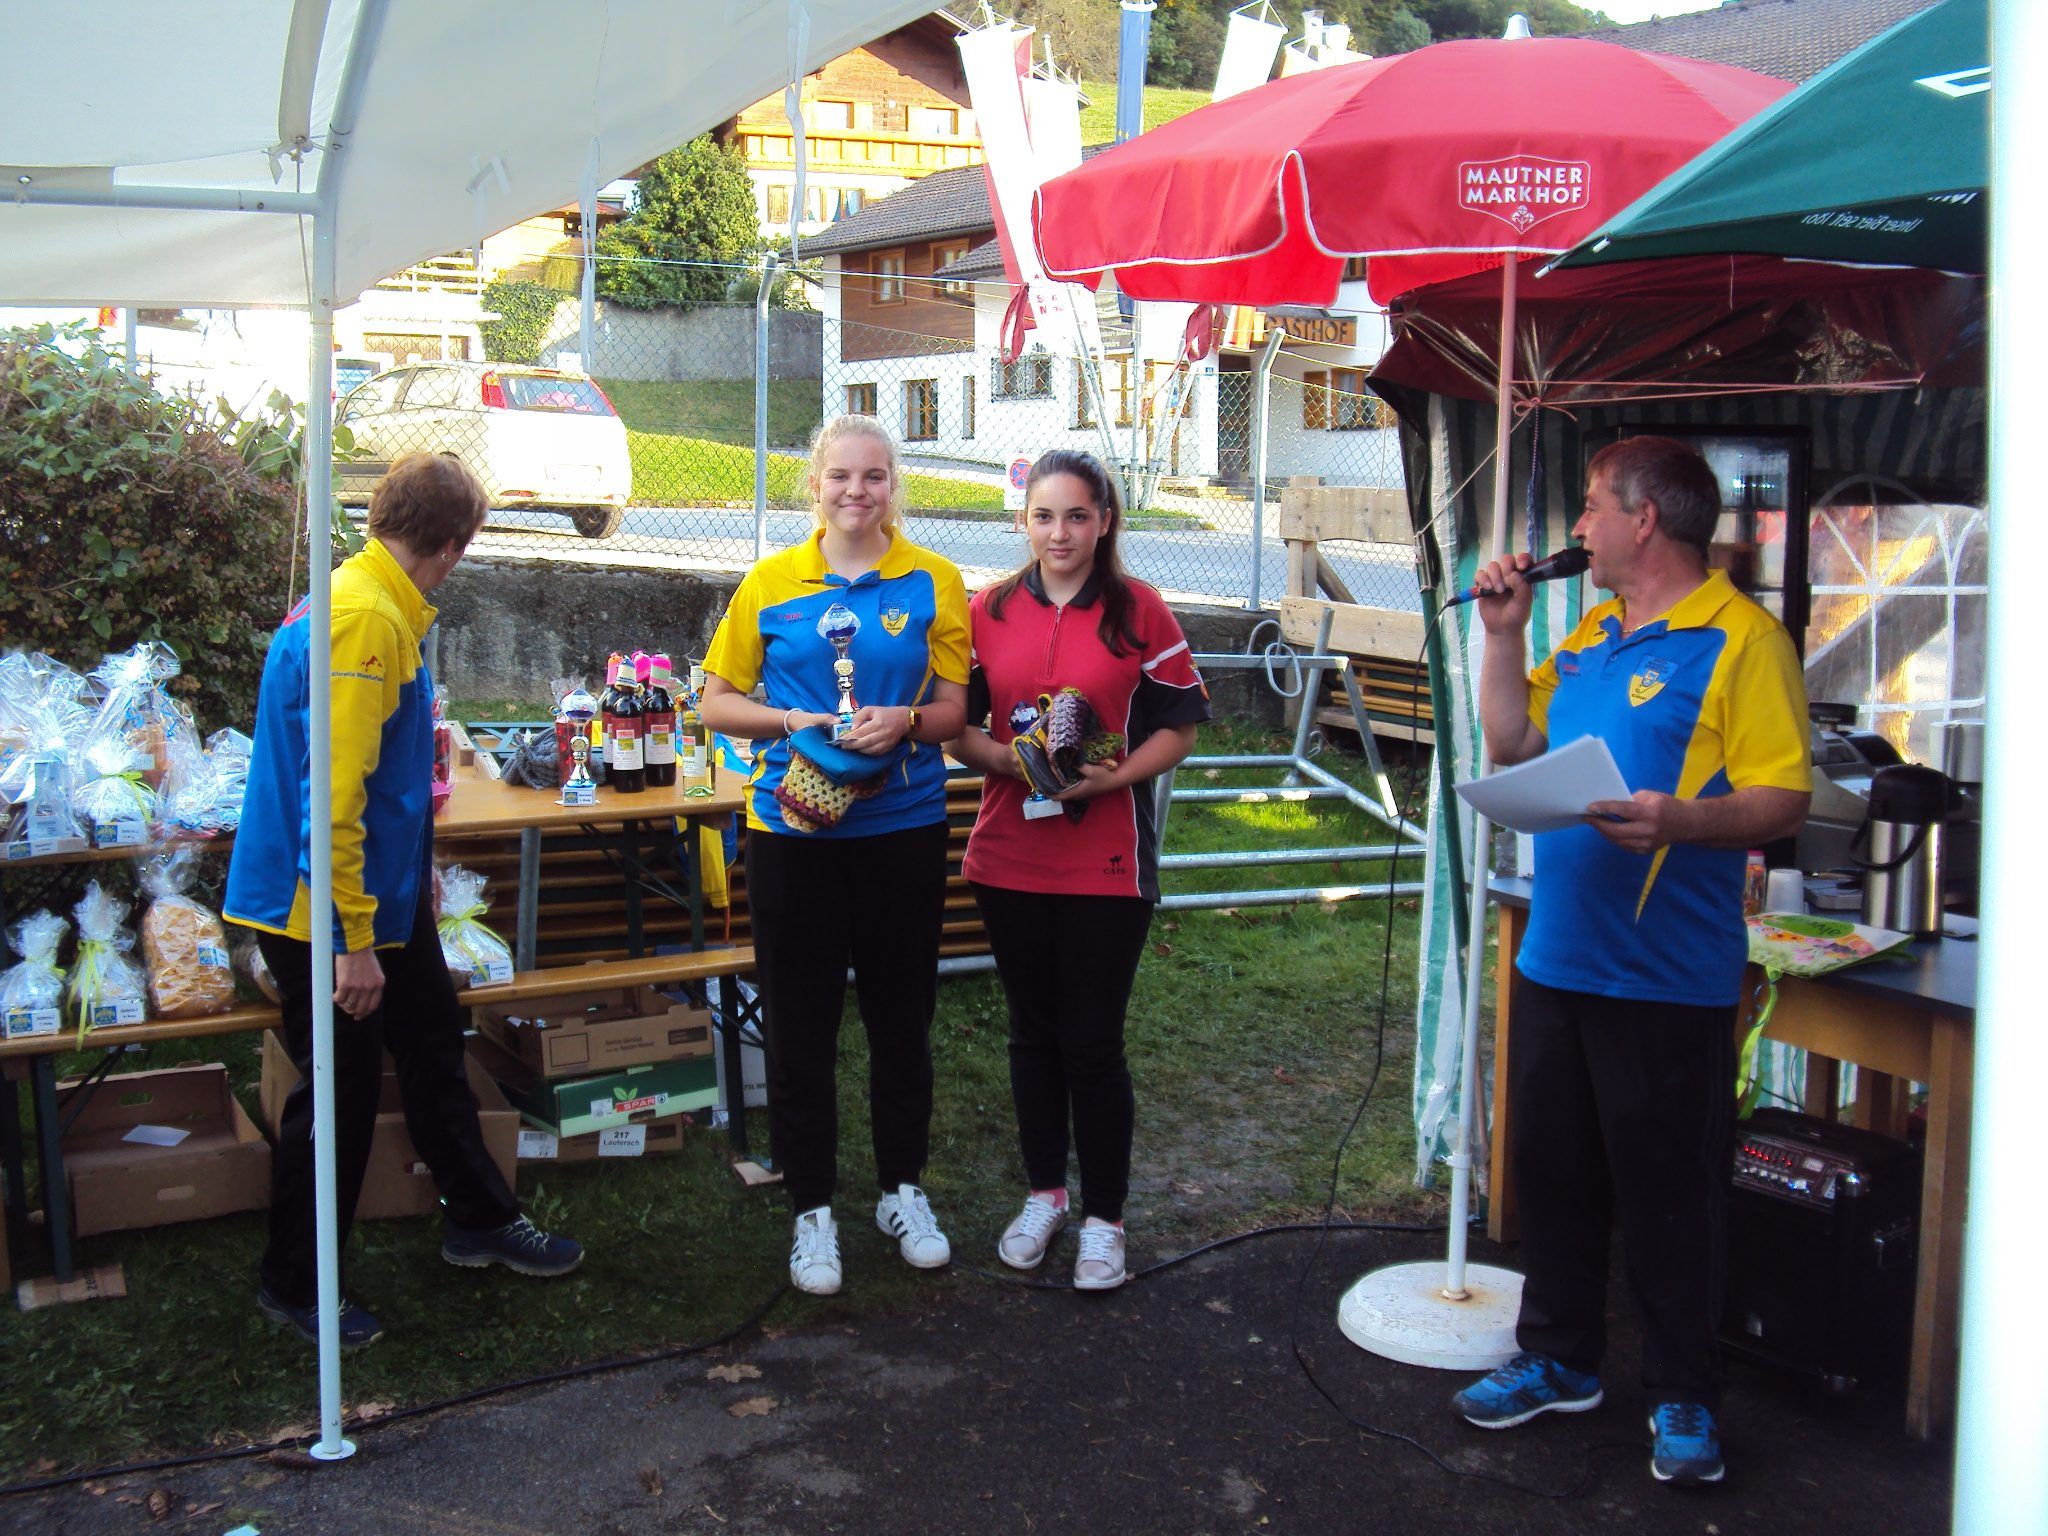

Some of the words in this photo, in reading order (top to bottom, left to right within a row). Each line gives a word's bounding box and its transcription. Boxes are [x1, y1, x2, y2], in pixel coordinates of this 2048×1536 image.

[1466, 166, 1584, 185] MAUTNER
[1466, 185, 1583, 204] MARKHOF
[623, 1097, 655, 1111] SPAR
[614, 1131, 630, 1139] 217
[603, 1139, 640, 1147] Lauterach
